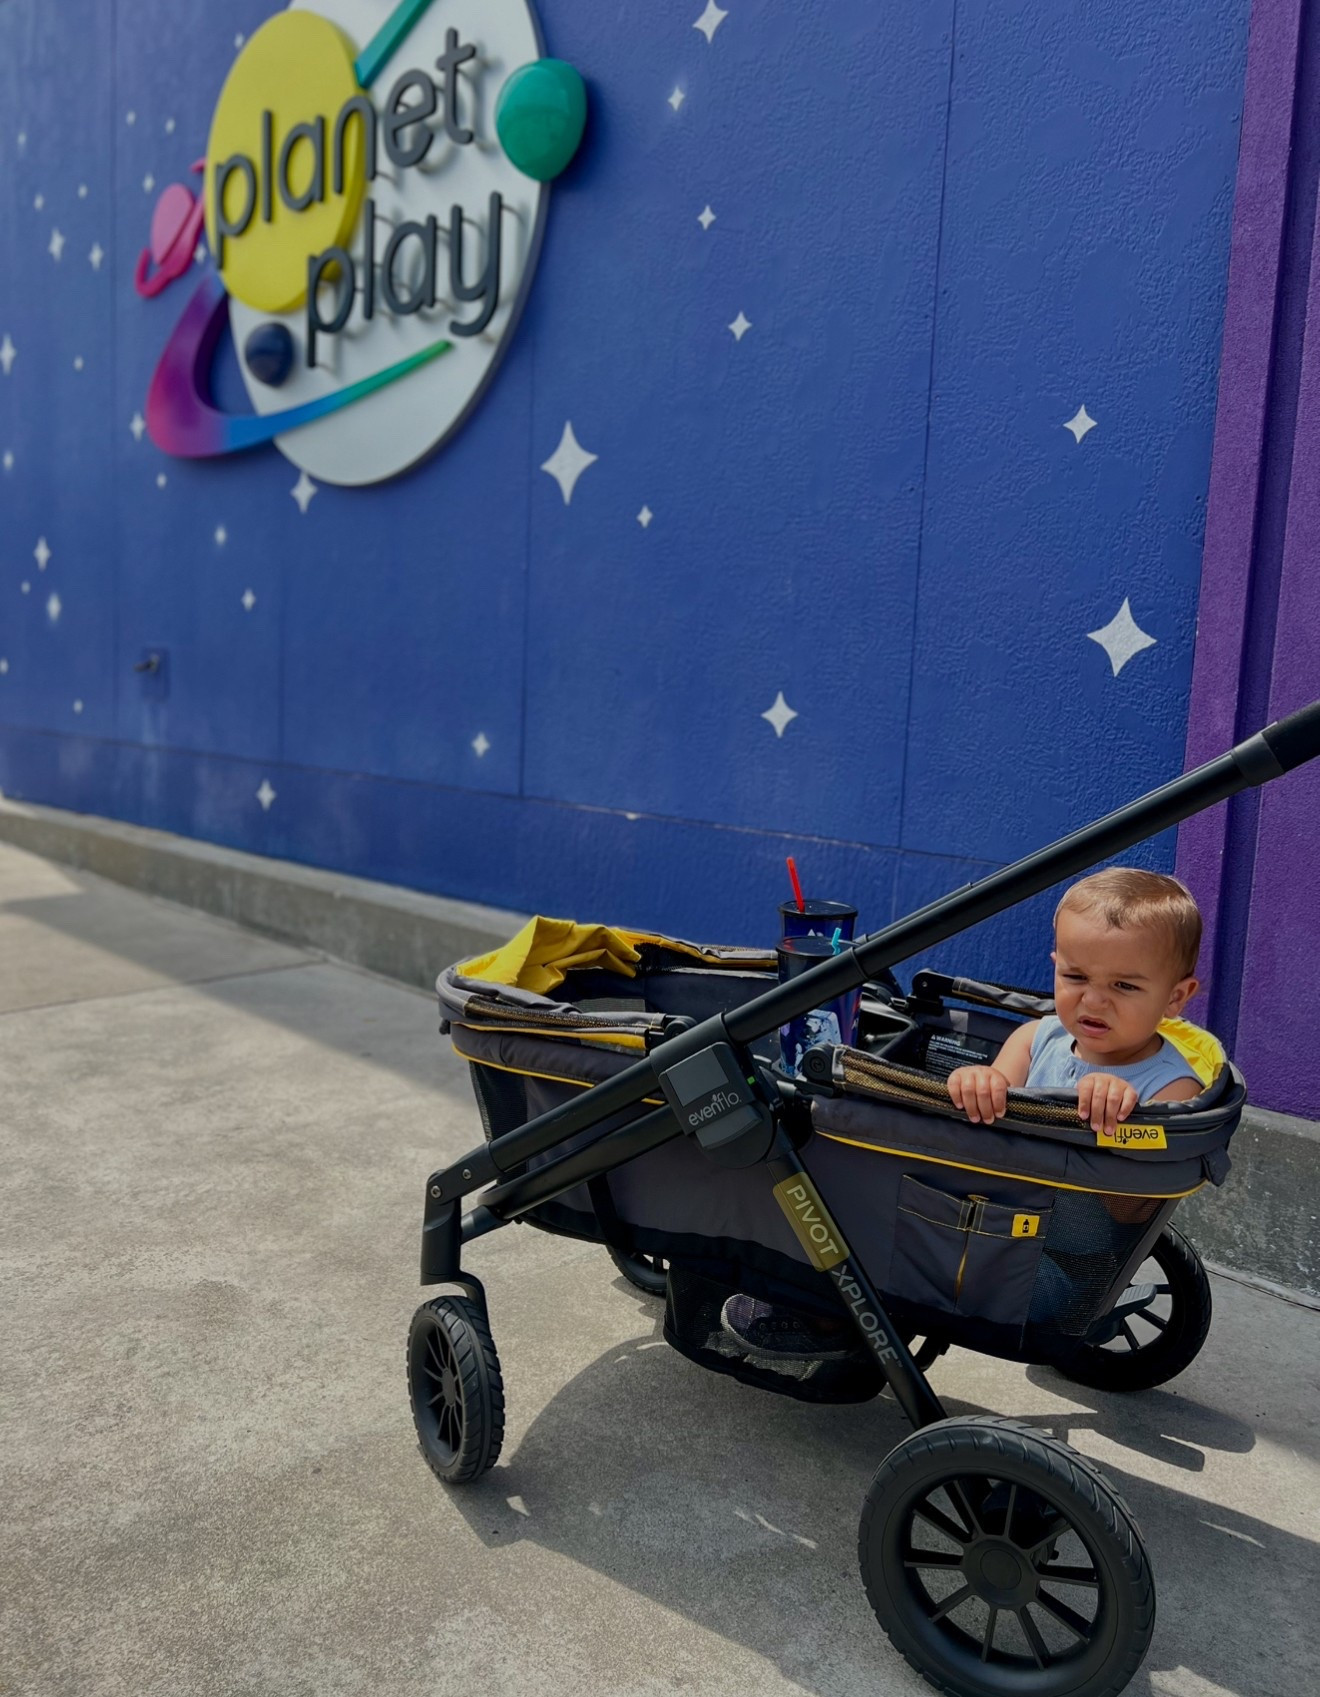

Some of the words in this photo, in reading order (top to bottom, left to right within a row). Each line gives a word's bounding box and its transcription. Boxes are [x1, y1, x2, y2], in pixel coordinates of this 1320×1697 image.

[214, 27, 476, 271] planet
[307, 190, 503, 369] play
[688, 1091, 740, 1126] evenflo
[1113, 1127, 1159, 1144] evenfl
[786, 1184, 840, 1257] PIVOT
[831, 1264, 899, 1365] XPLORE
